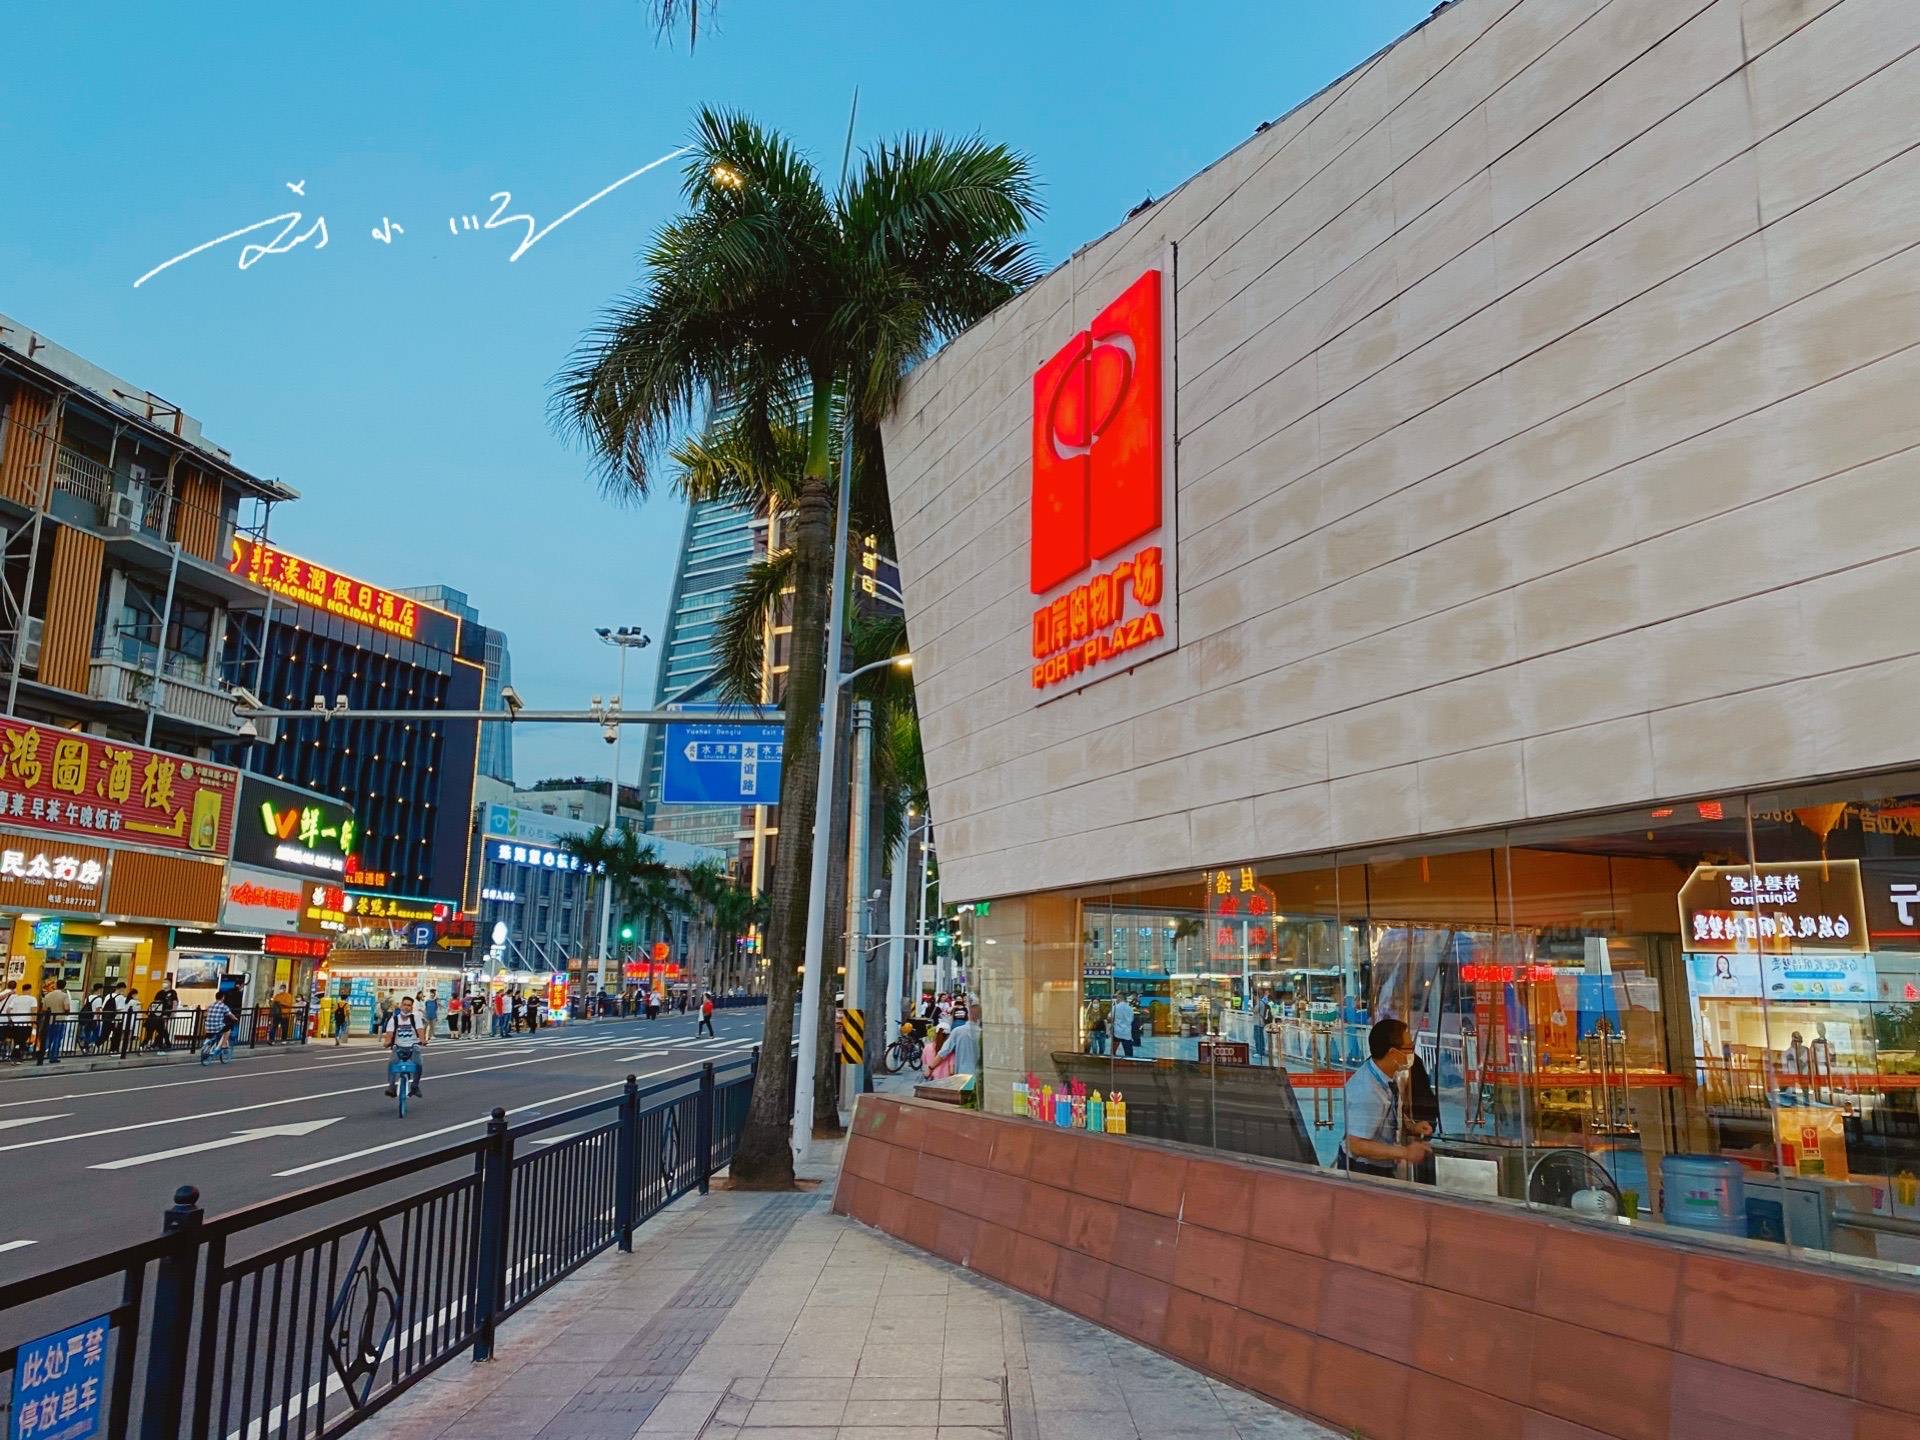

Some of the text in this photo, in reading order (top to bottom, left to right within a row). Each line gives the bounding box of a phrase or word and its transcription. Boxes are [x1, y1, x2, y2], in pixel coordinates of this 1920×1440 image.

[326, 598, 377, 625] HOLIDAY
[378, 616, 413, 638] HOTEL
[1033, 547, 1162, 659] 口岸购物广场
[1032, 612, 1163, 688] PORT PLAZA
[742, 746, 755, 792] 友谊路
[31, 797, 61, 822] 早茶
[65, 802, 123, 831] 午晚饭市
[0, 851, 102, 885] 民众药房
[21, 1327, 104, 1392] 此处严禁
[18, 1376, 98, 1440] 停放单车
